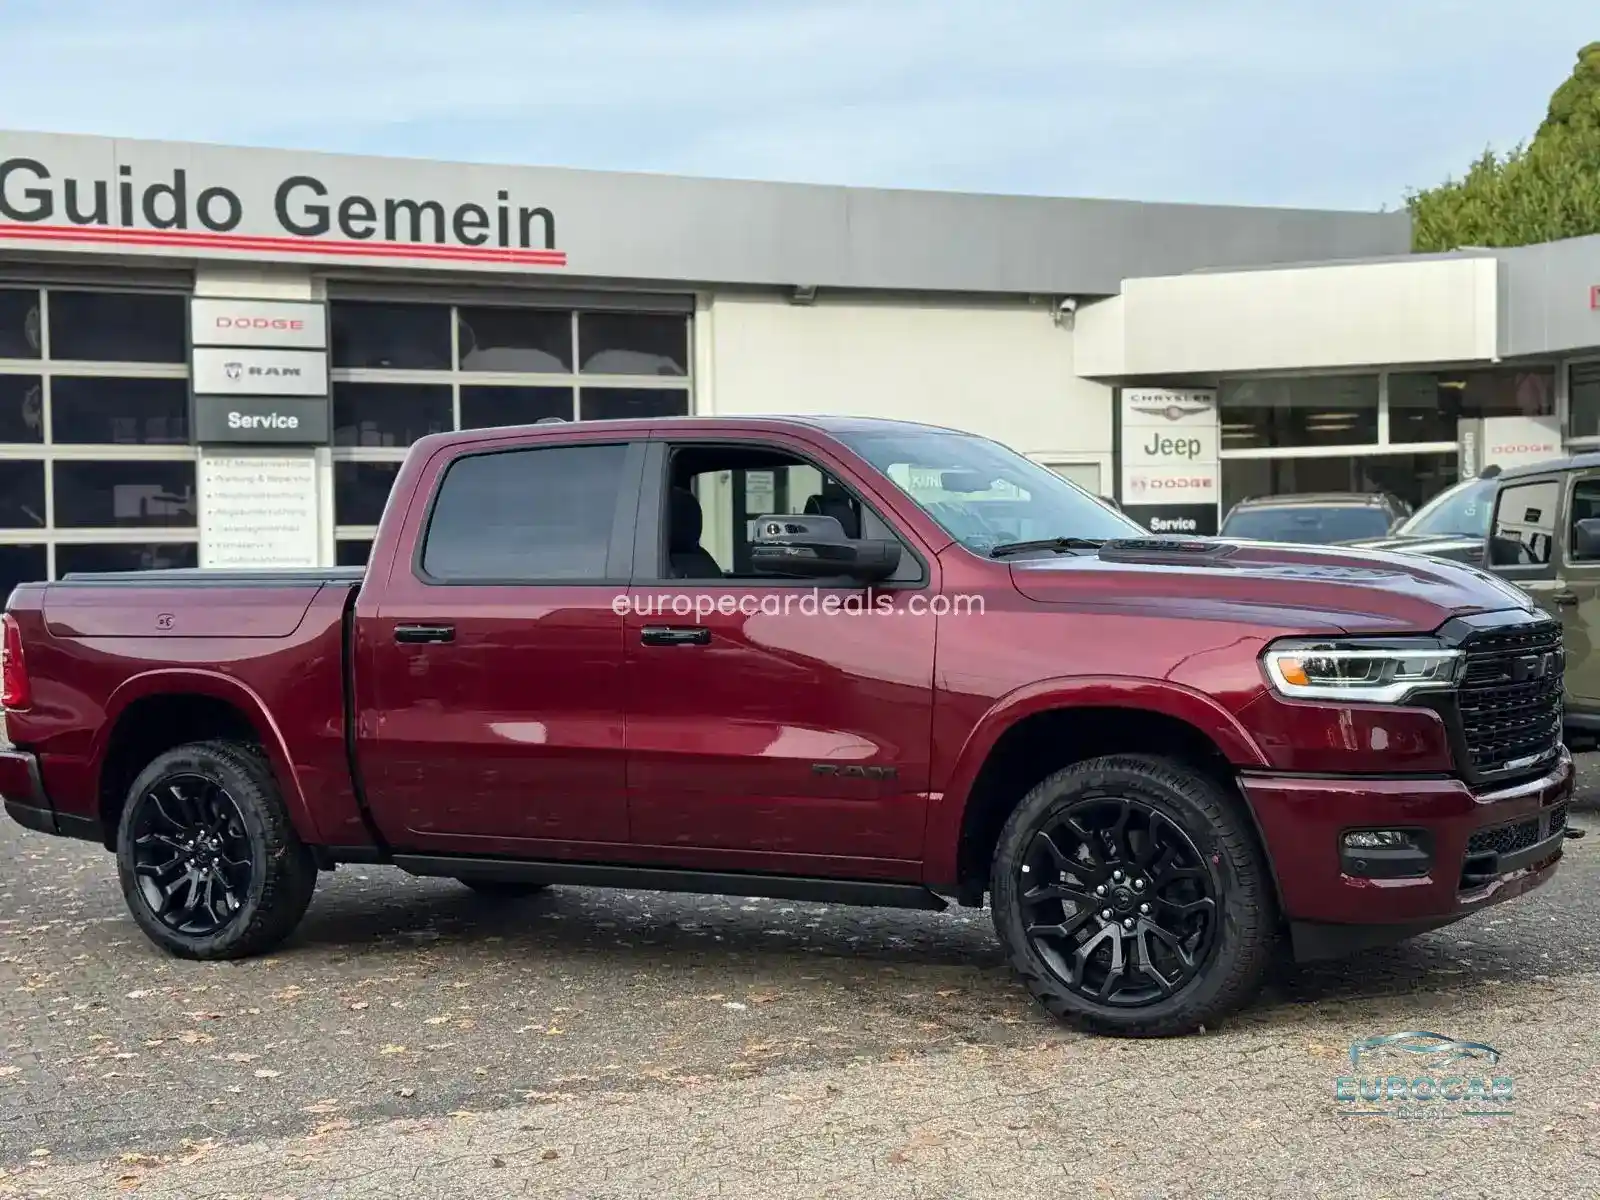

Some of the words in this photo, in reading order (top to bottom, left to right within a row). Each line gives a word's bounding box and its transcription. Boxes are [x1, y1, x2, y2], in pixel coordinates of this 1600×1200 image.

[0, 158, 242, 232] Guido
[274, 175, 556, 249] Gemein
[216, 317, 304, 330] DODGE
[248, 366, 301, 376] RAM
[1130, 394, 1211, 402] CHRYSLER
[227, 411, 299, 429] Service
[1144, 432, 1201, 459] Jeep
[1491, 444, 1554, 454] DODGE
[1150, 478, 1212, 488] DODGE
[1150, 517, 1197, 530] Service
[812, 763, 898, 780] RAM
